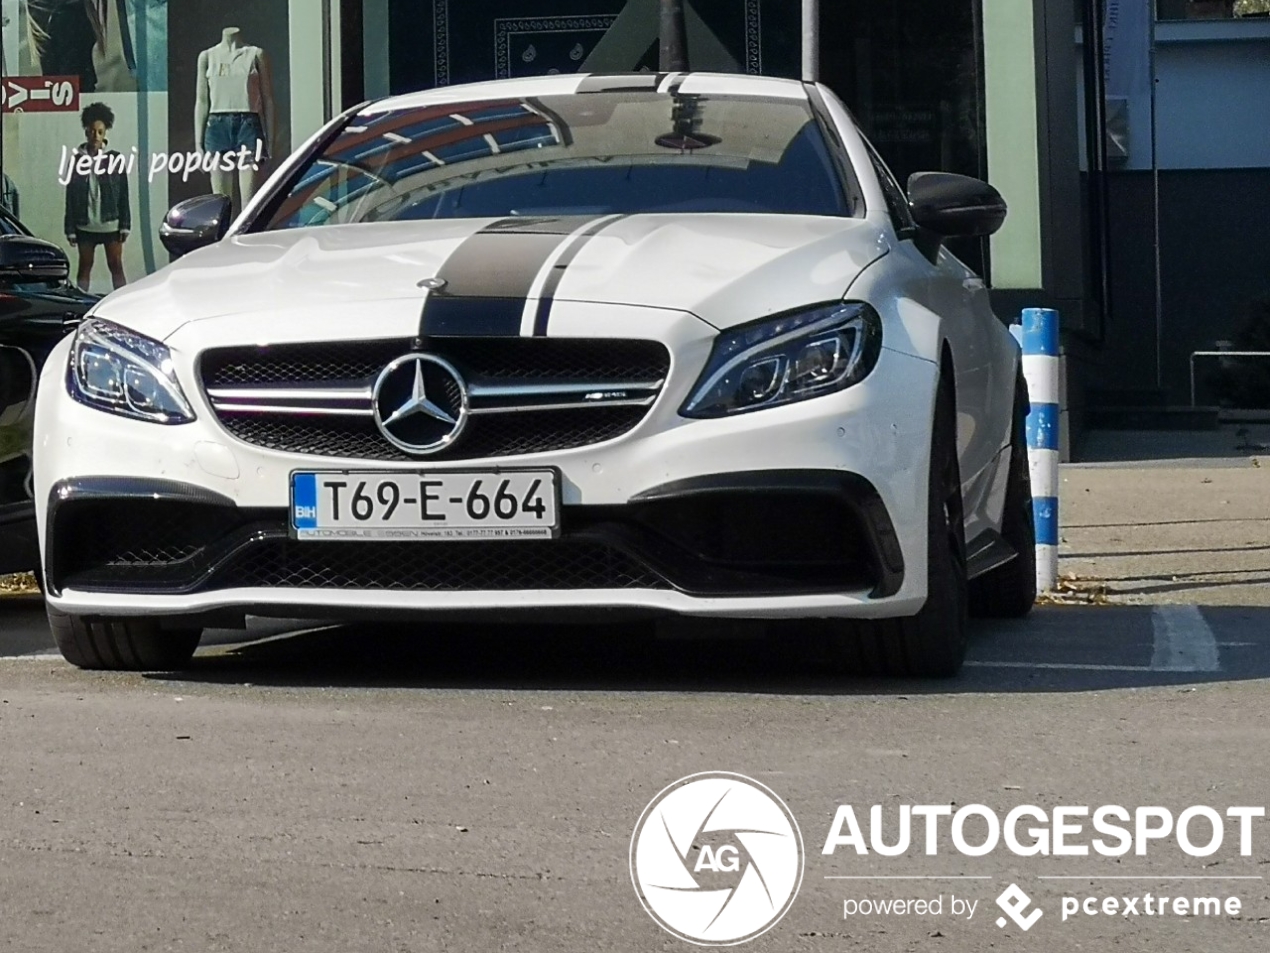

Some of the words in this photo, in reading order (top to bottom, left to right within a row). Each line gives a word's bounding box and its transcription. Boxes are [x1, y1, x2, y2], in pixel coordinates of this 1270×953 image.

[147, 138, 263, 183] popust!
[295, 505, 316, 519] BIH
[323, 479, 547, 521] T69-E-664
